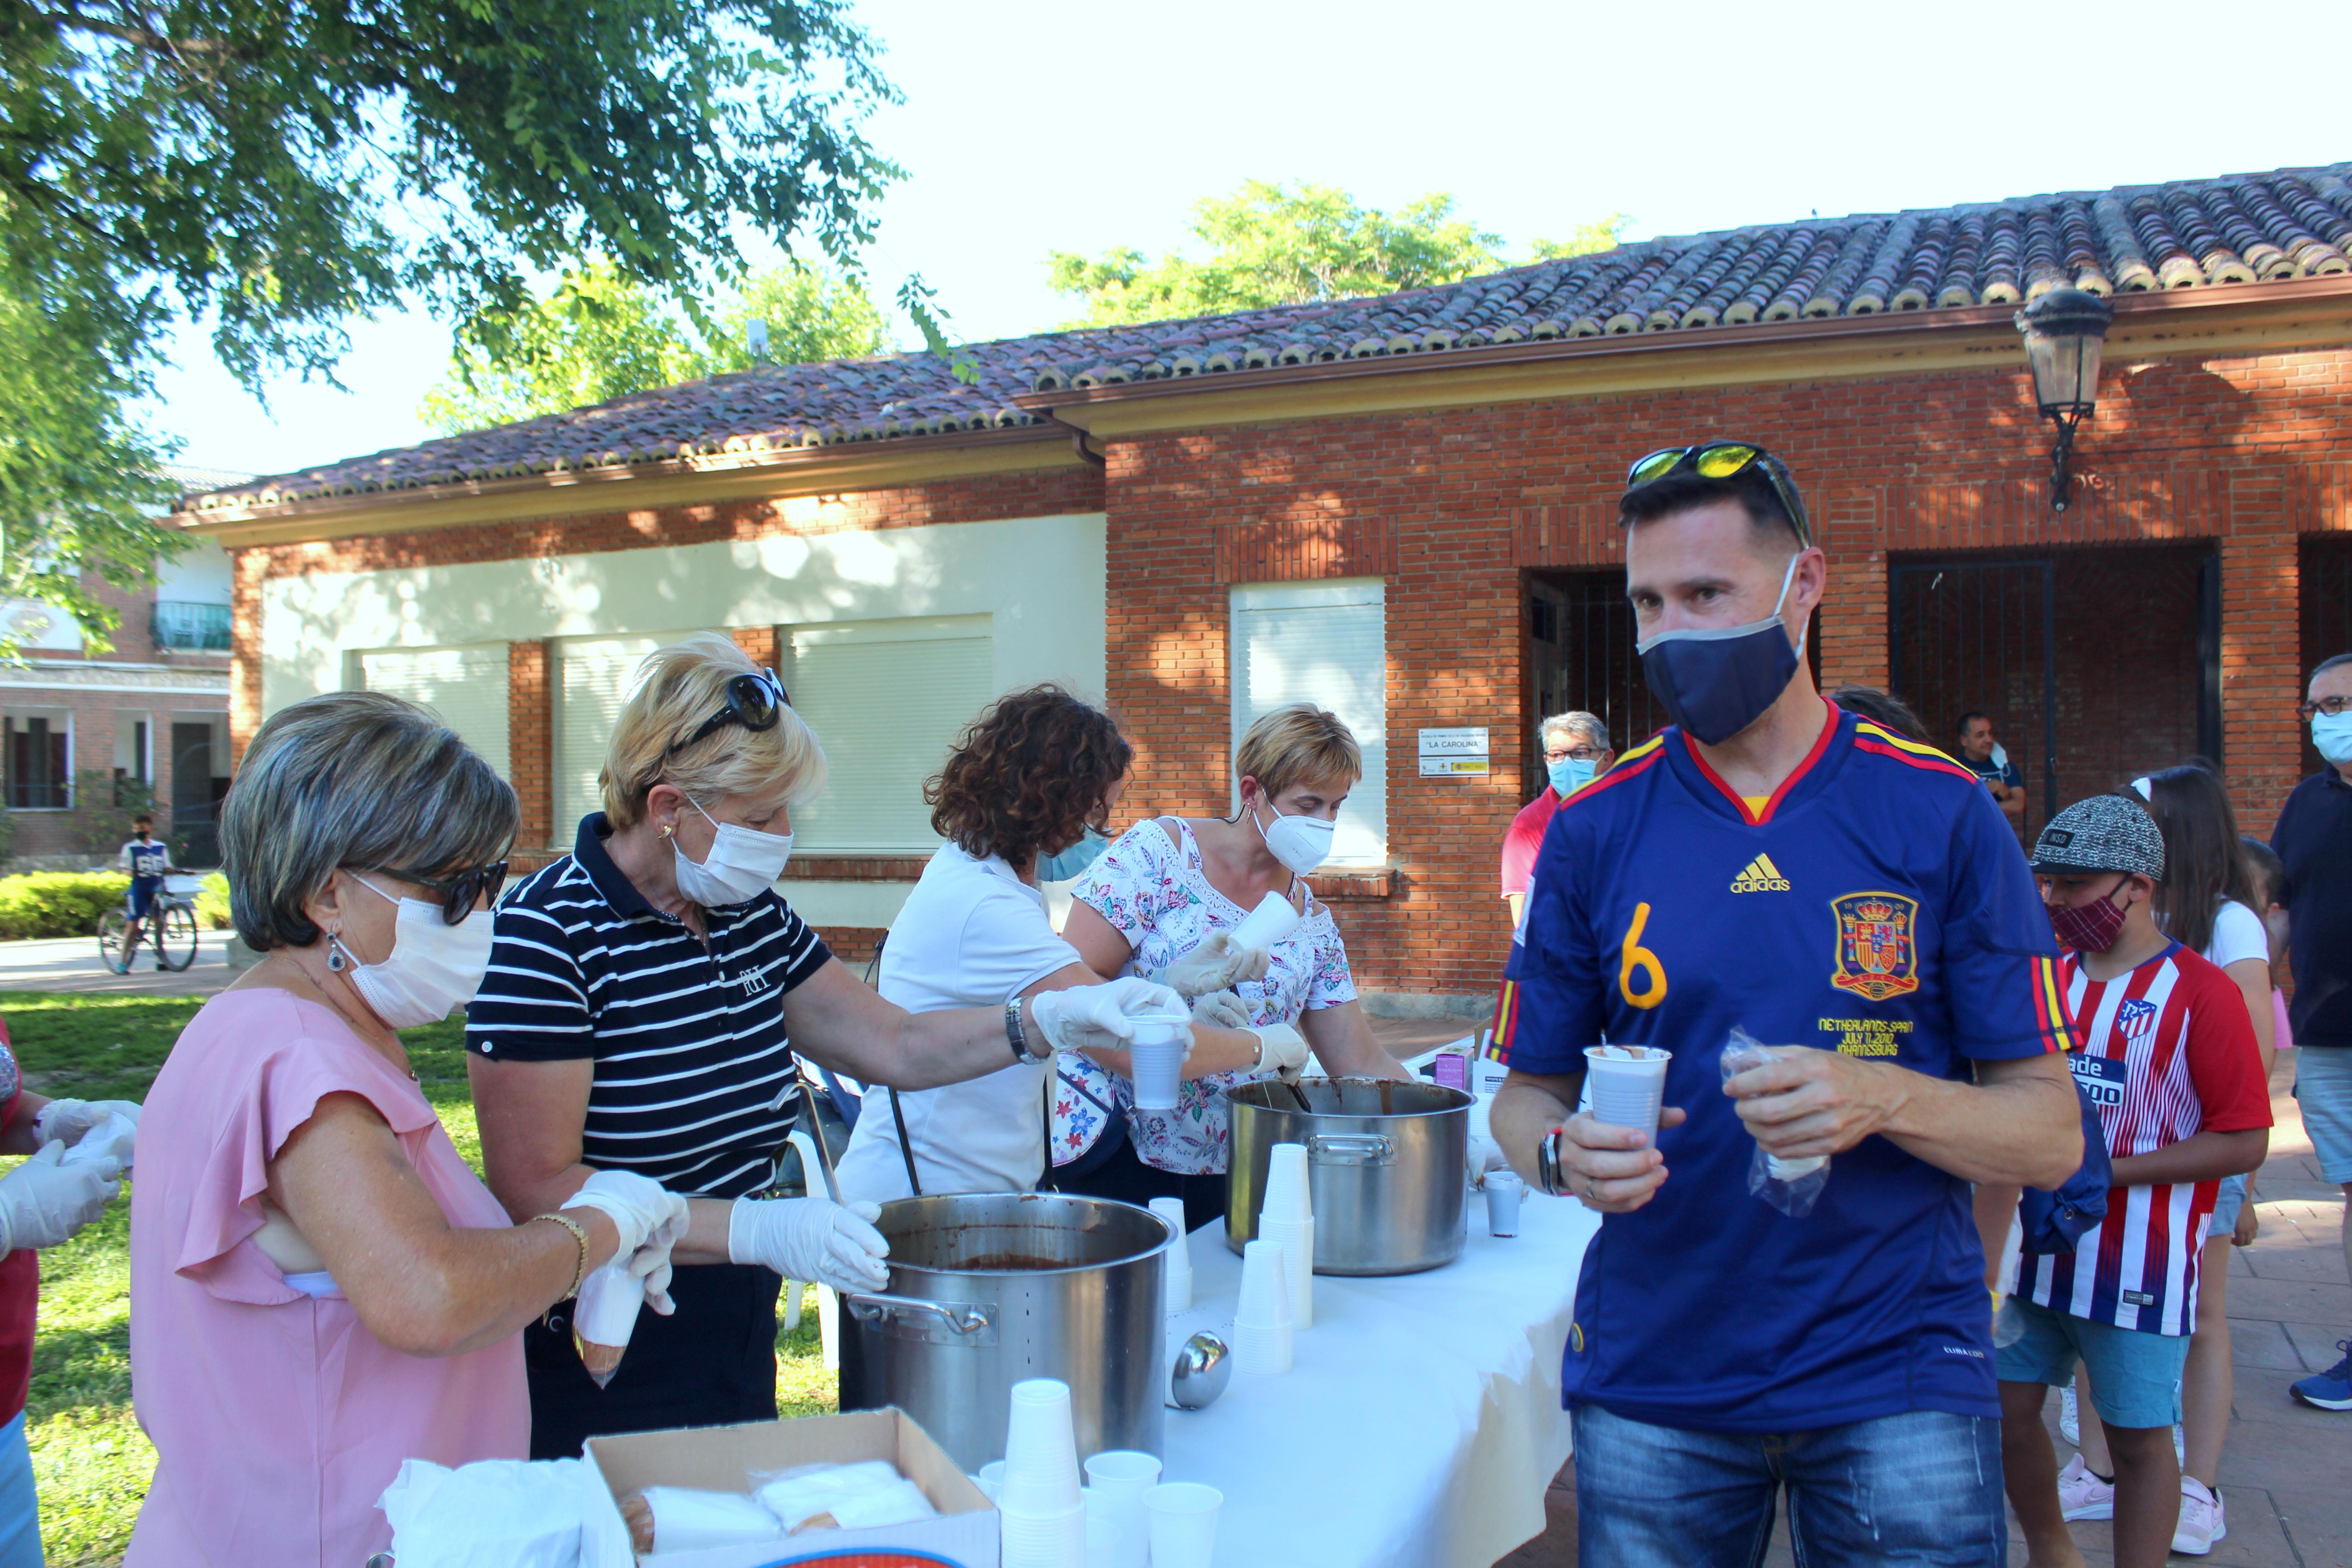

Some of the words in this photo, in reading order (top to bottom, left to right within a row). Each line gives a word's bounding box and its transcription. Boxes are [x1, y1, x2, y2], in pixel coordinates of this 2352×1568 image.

[1730, 878, 1791, 893] adidas
[1619, 902, 1667, 1009] 6
[1841, 1033, 1863, 1044] JULY
[2067, 1056, 2102, 1077] ade
